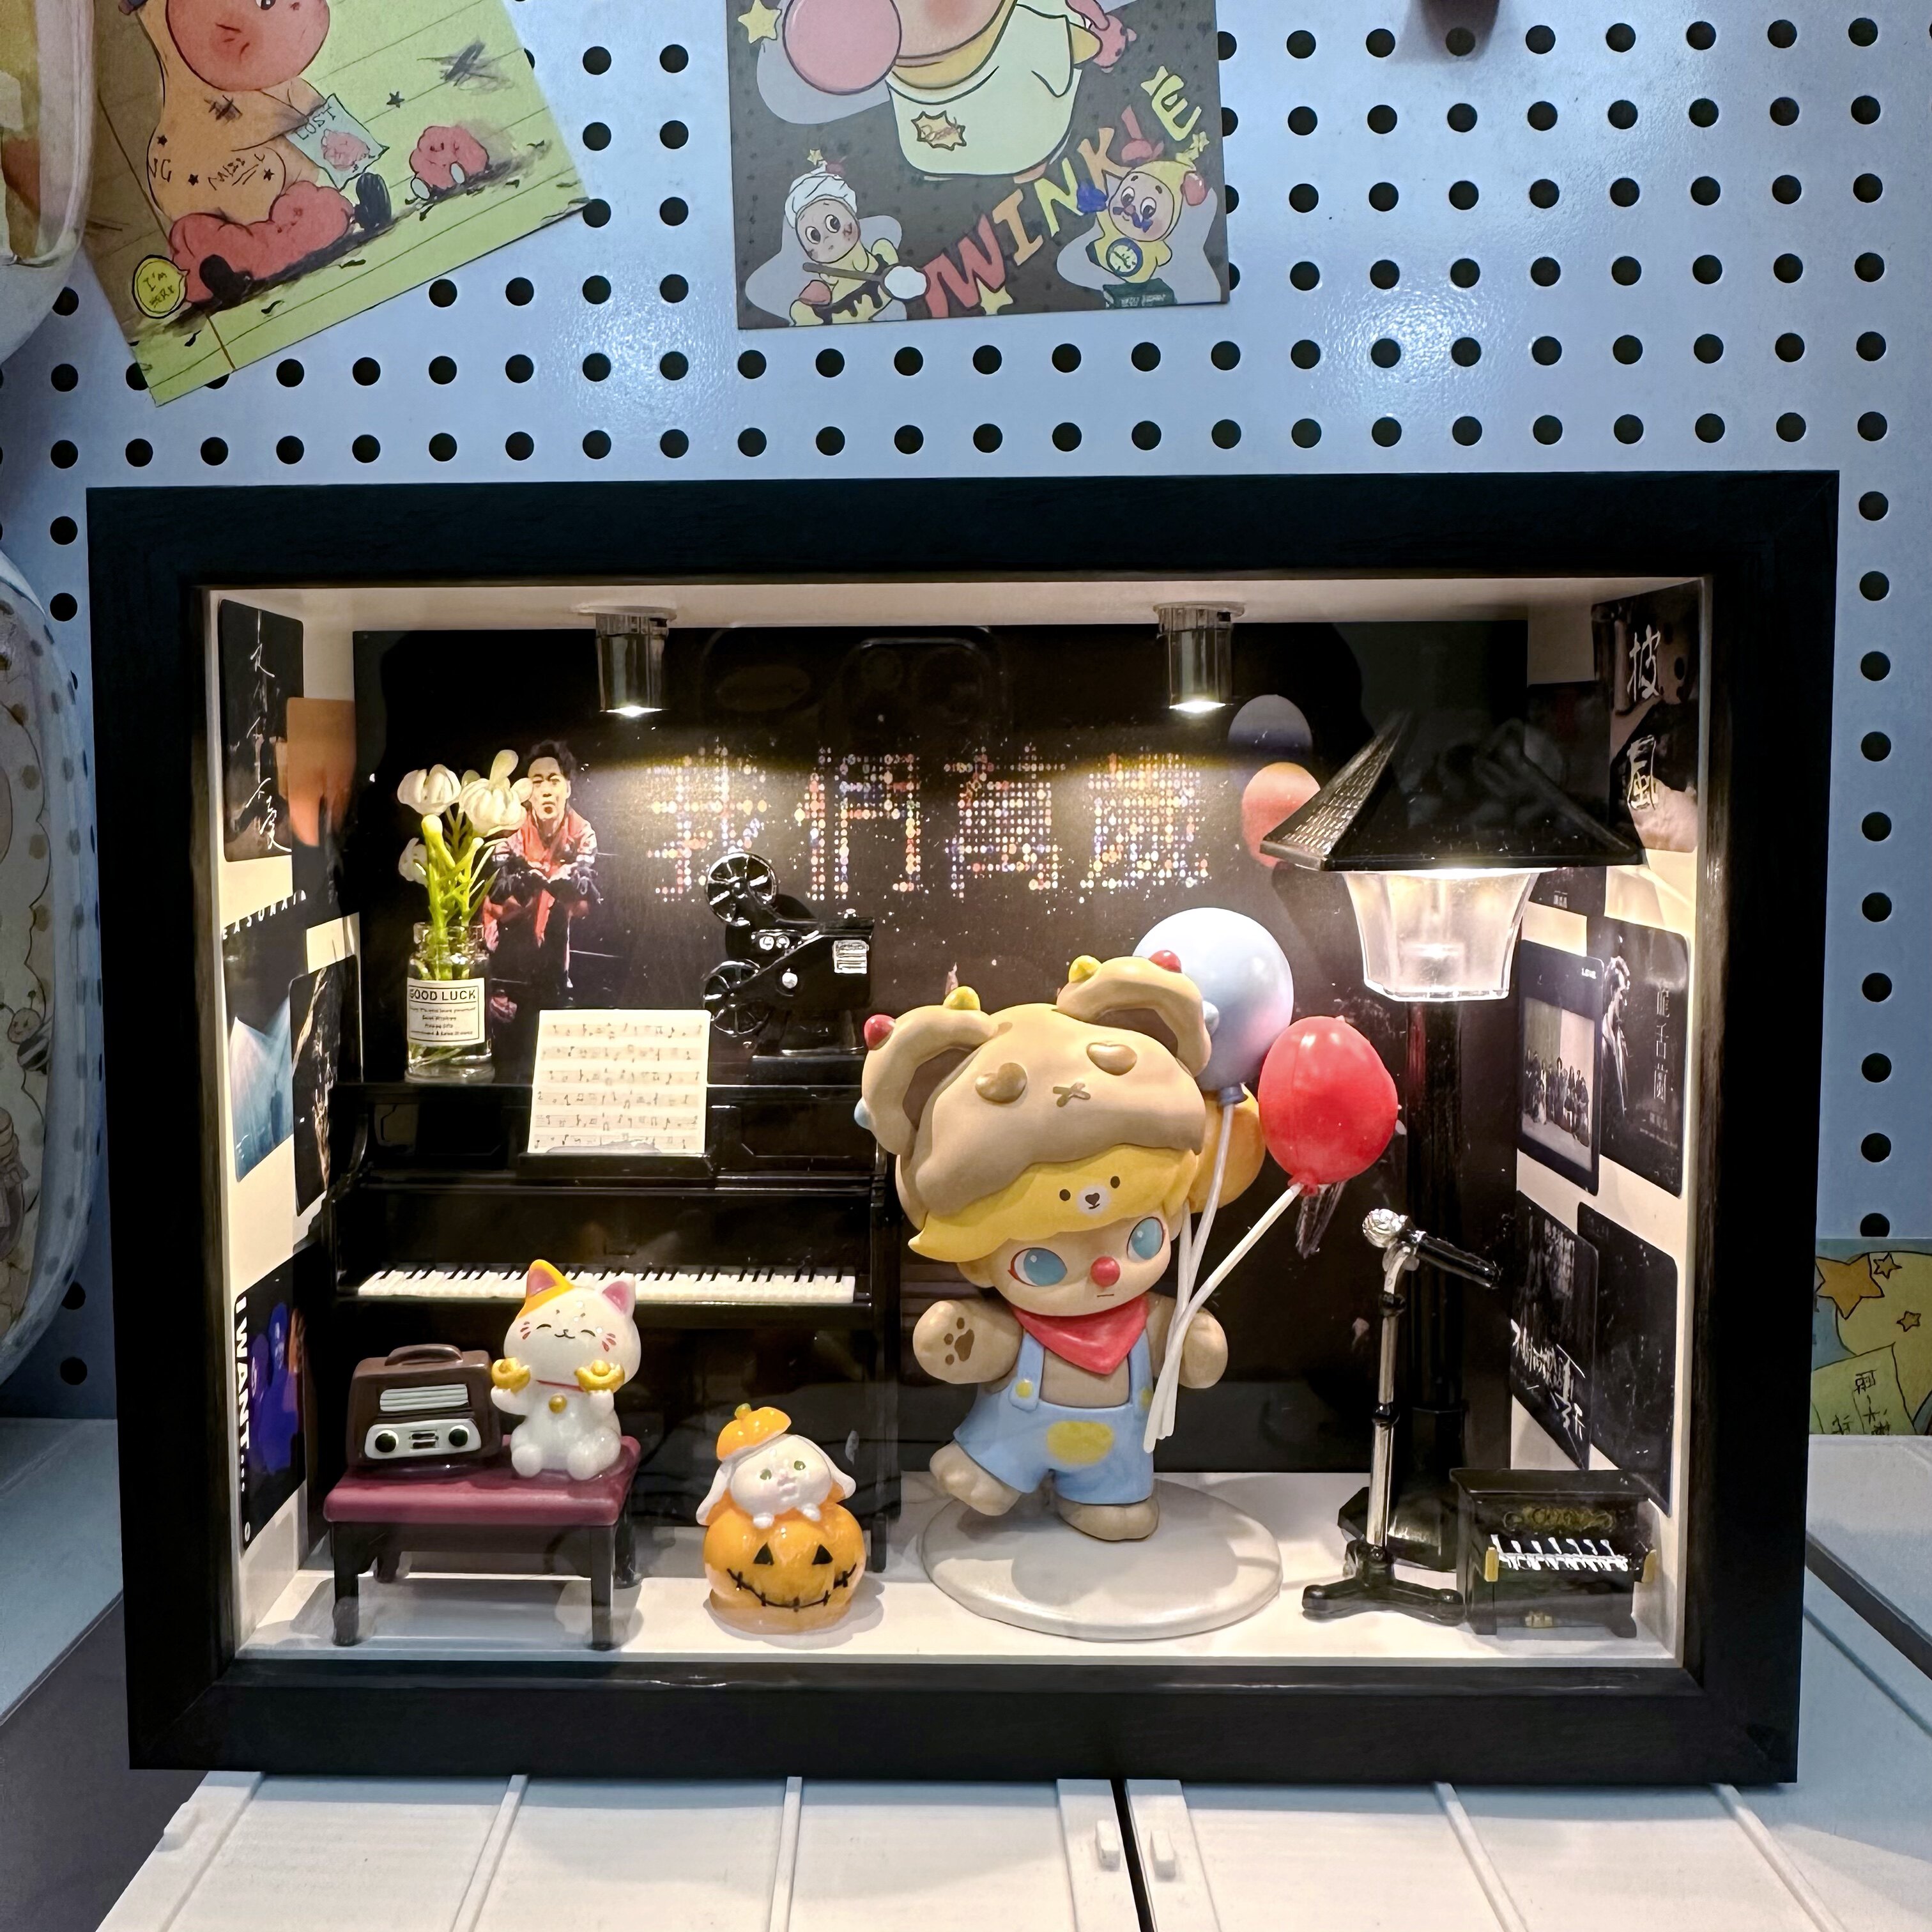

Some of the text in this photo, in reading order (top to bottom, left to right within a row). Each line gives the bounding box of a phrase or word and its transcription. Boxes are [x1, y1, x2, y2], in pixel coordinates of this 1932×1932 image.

[295, 105, 337, 141] LOST
[409, 988, 476, 1001] GOOD LUCK
